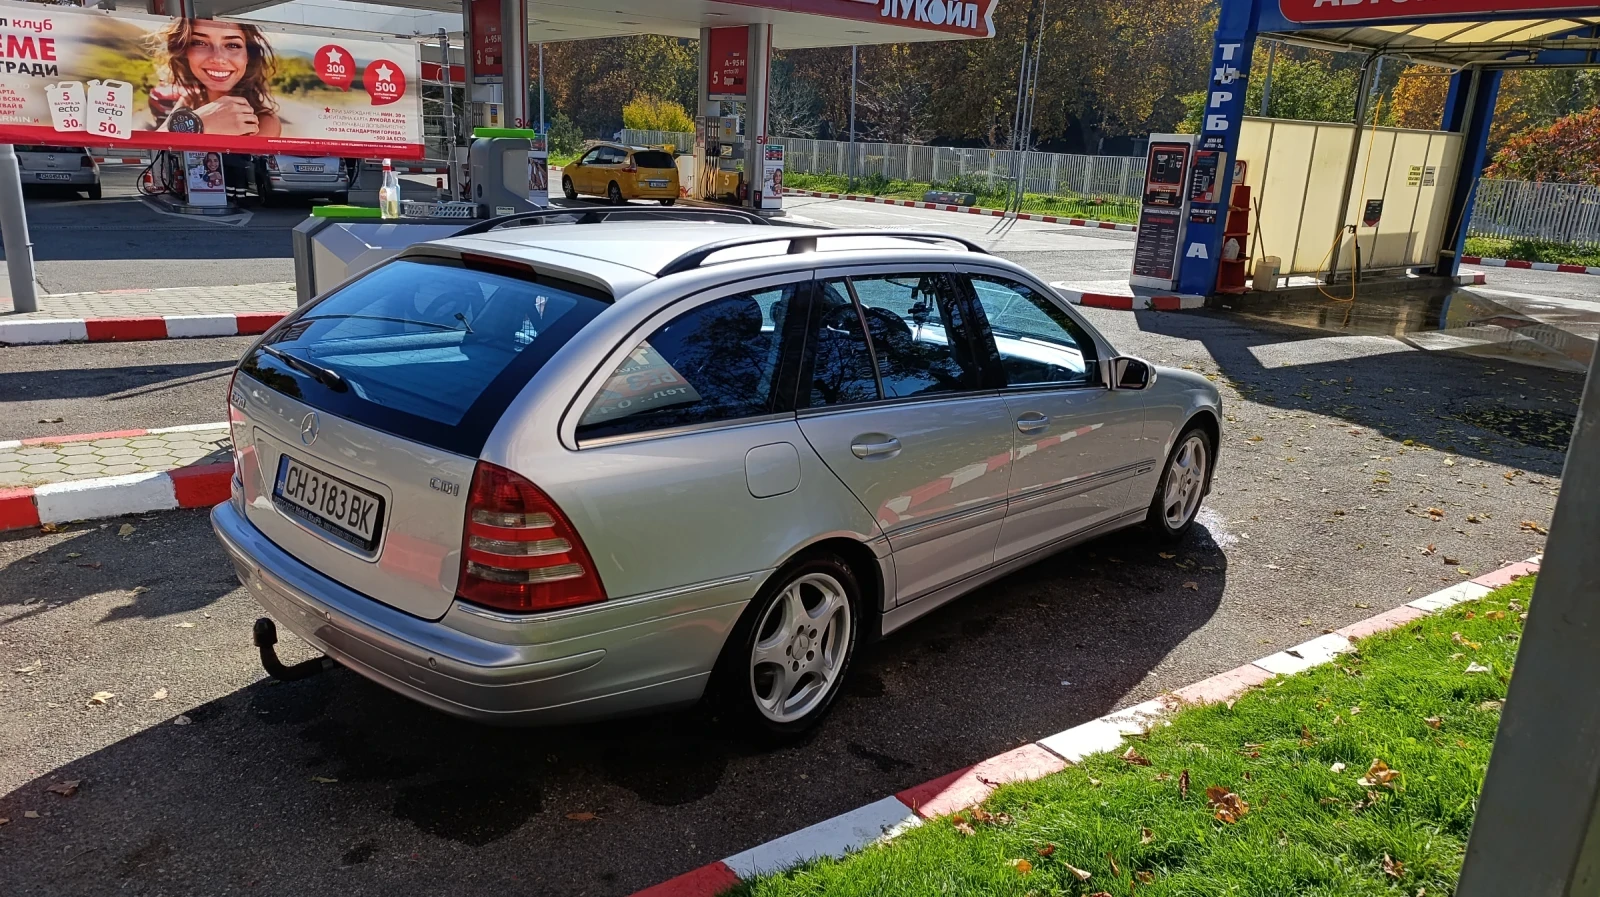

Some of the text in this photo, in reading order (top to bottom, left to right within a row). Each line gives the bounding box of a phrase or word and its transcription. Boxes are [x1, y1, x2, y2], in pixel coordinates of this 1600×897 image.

[12, 19, 53, 33] клуб
[0, 34, 56, 61] МЕ
[0, 61, 59, 77] РАДИ
[326, 64, 345, 73] 300
[712, 71, 719, 85] 5
[375, 83, 396, 92] 500
[62, 91, 70, 101] 5
[106, 91, 116, 102] 5
[58, 105, 80, 113] ecto
[97, 106, 123, 117] ecto
[724, 174, 730, 186] 5
[430, 477, 459, 496] CDI
